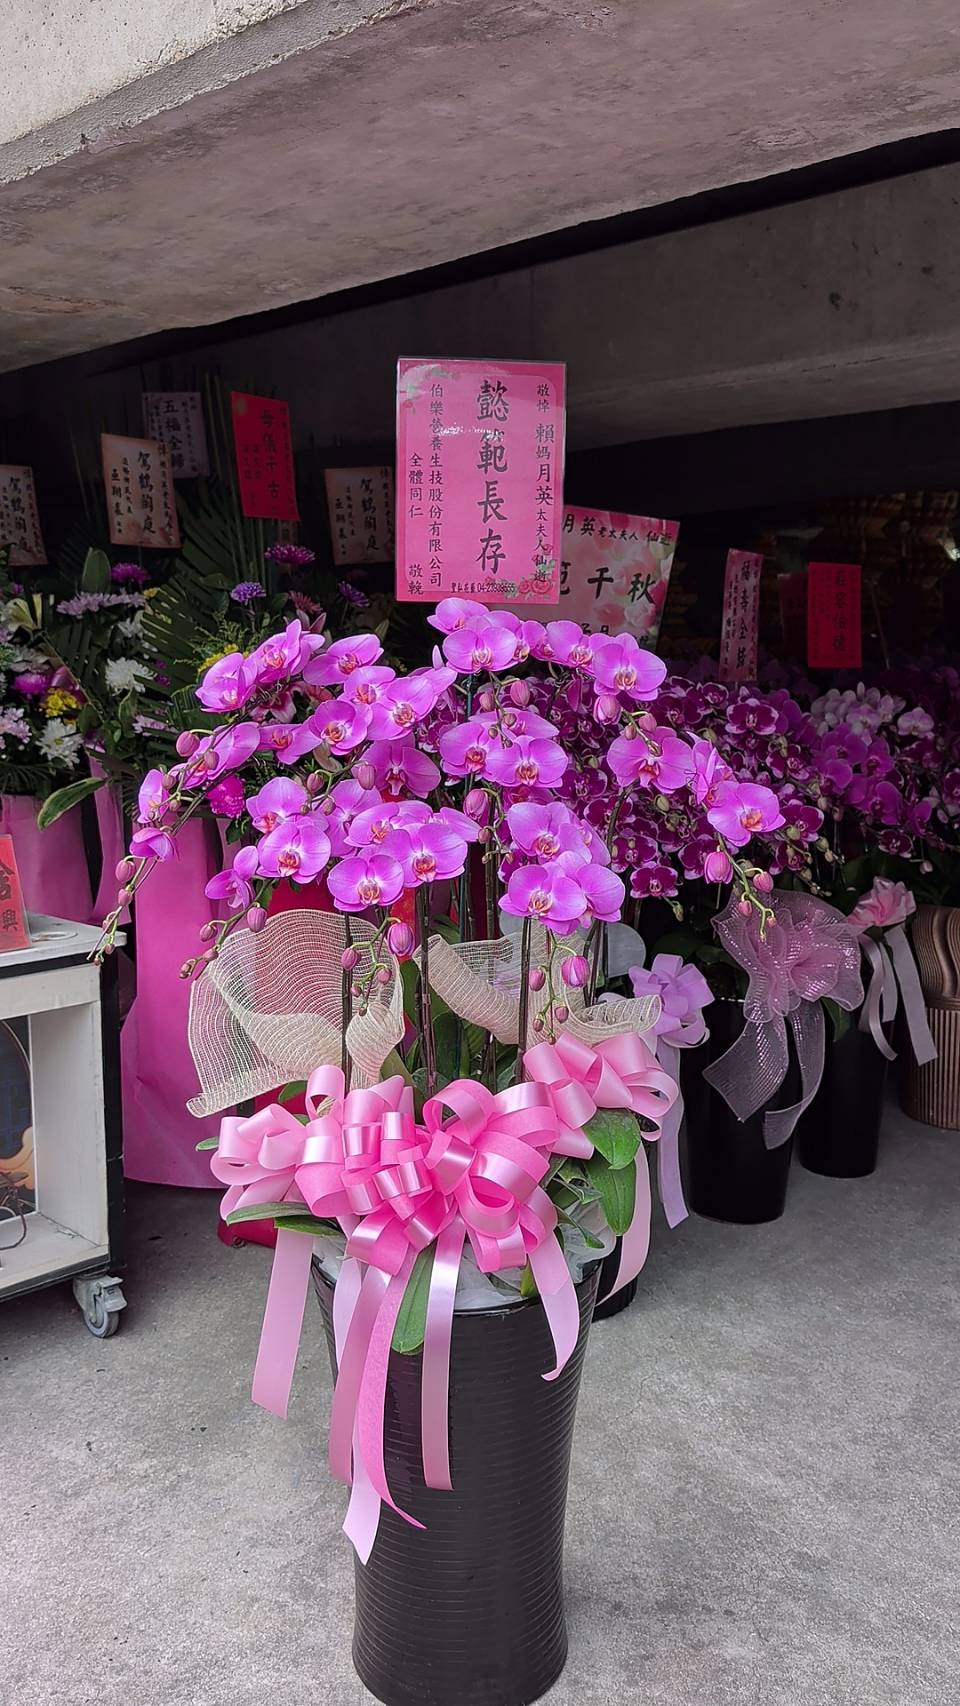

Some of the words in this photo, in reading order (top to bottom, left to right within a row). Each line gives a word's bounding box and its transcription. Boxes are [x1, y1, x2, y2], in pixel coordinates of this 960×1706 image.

[408, 452, 424, 518] 全體同仁
[475, 378, 510, 575] 懿範長存
